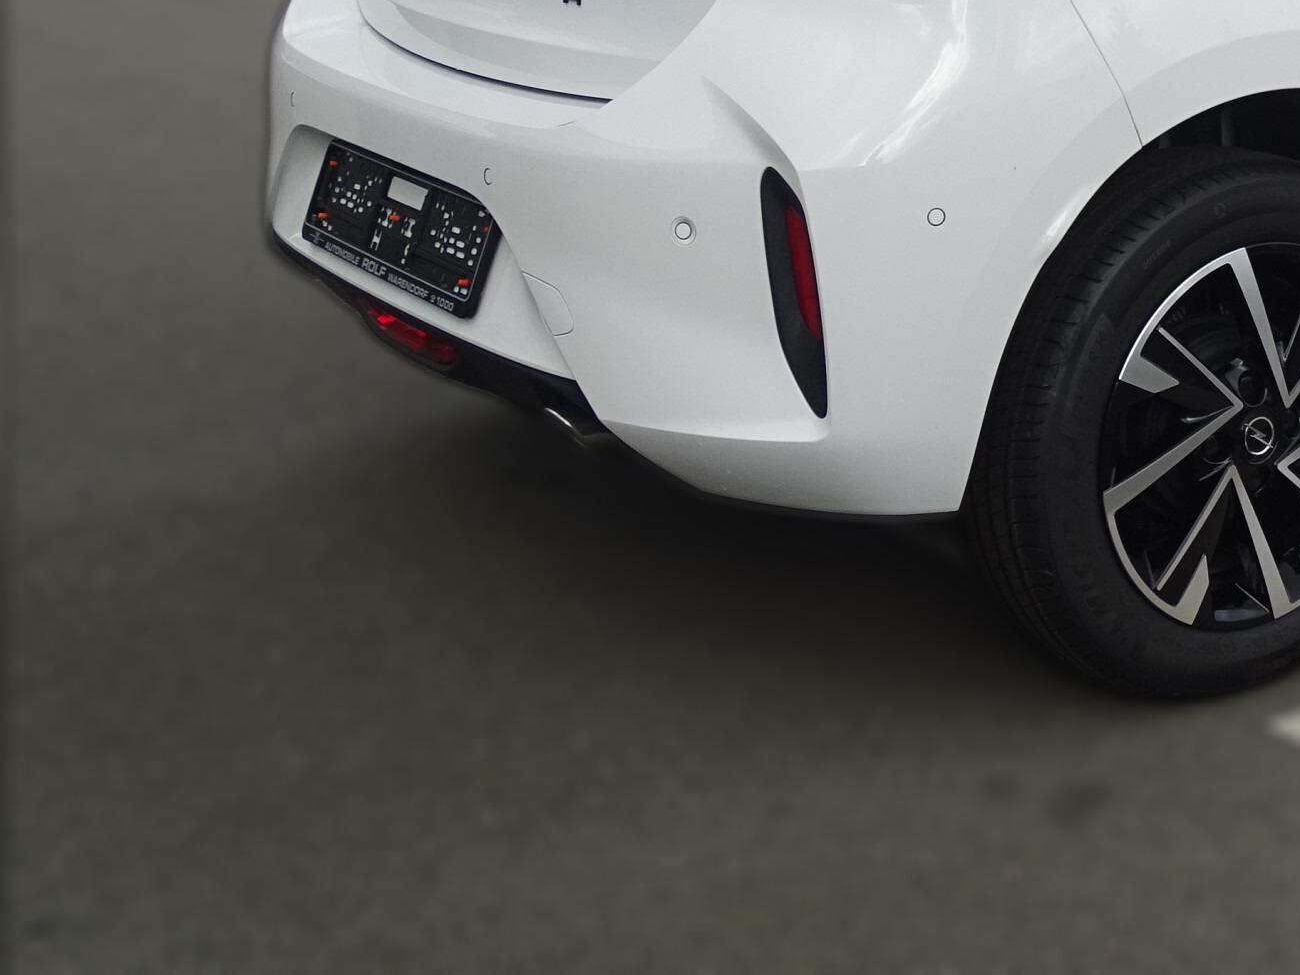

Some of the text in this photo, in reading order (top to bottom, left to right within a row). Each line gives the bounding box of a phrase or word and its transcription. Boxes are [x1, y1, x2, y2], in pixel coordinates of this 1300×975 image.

[324, 242, 360, 266] AUTOMOBILE
[361, 258, 387, 277] ROLF
[387, 273, 429, 298] WARENDORF
